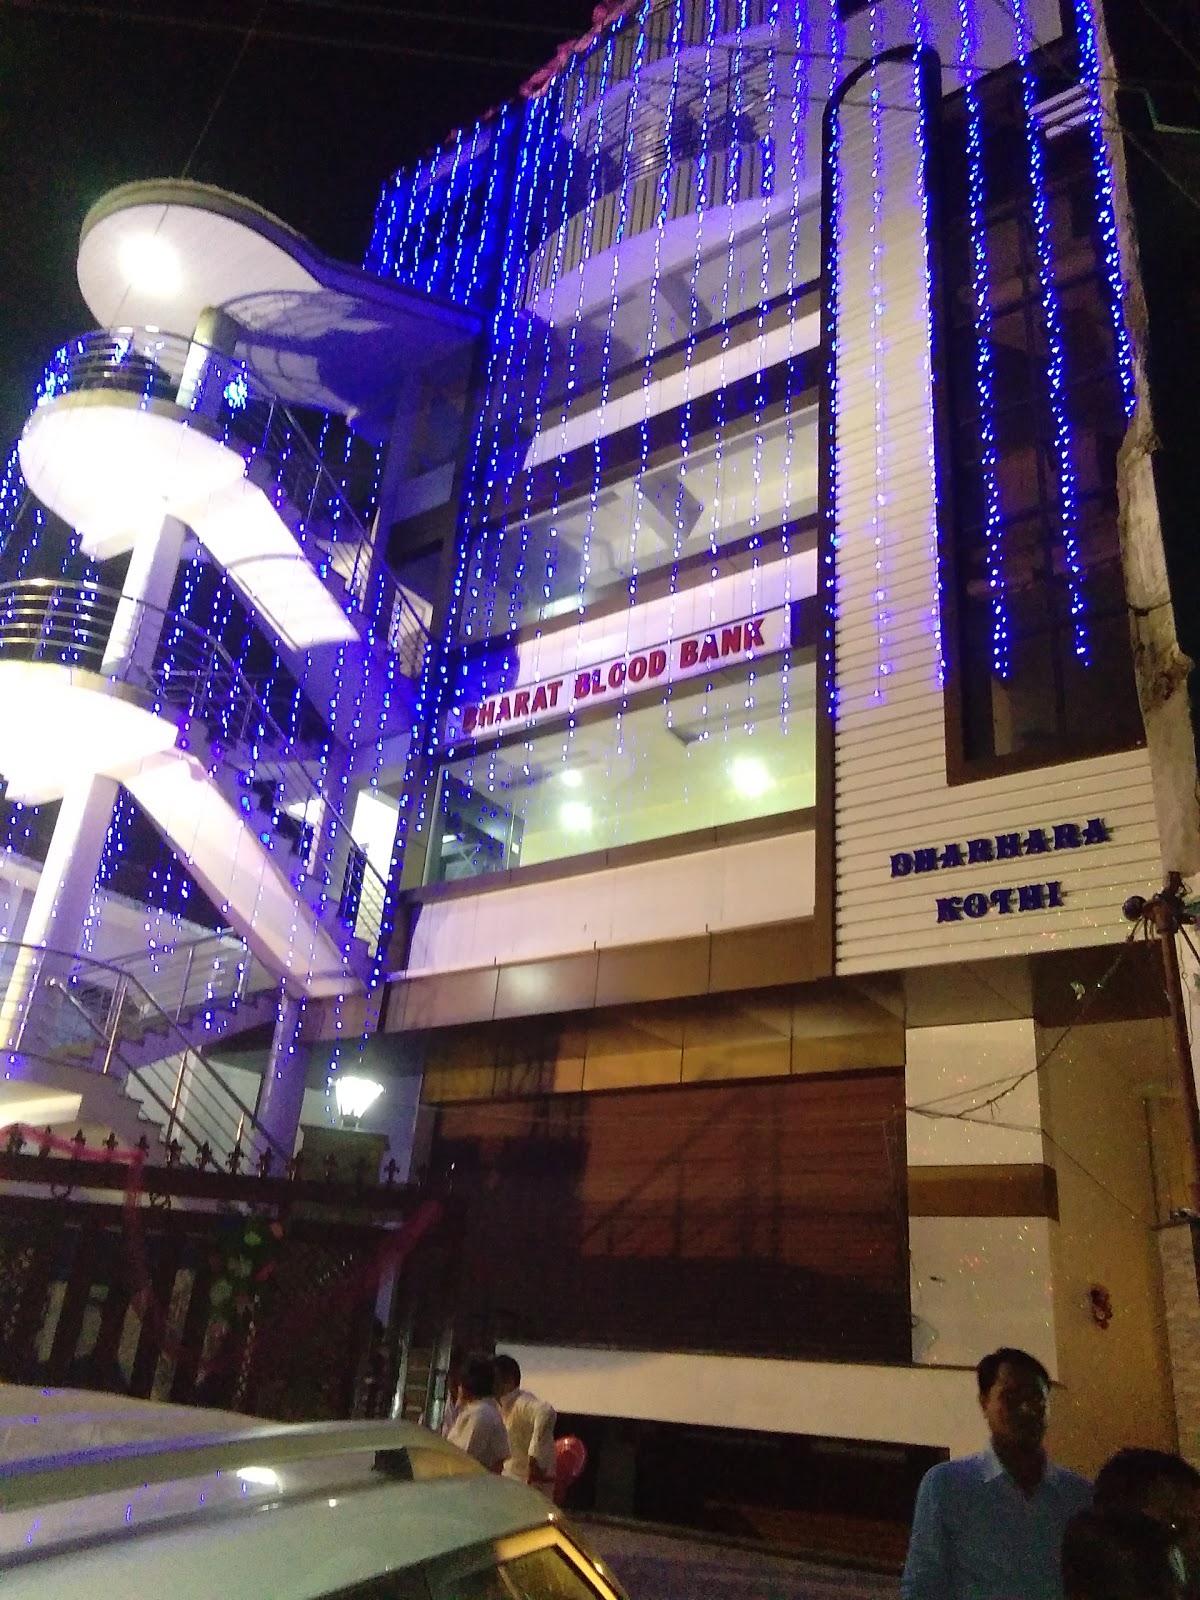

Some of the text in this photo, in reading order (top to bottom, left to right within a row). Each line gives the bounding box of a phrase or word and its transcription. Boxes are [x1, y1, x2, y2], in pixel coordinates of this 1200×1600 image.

[462, 618, 765, 734] BHARAT BLOOD BANK
[889, 817, 1112, 878] DHARHARA
[935, 881, 1065, 924] KOTHI
